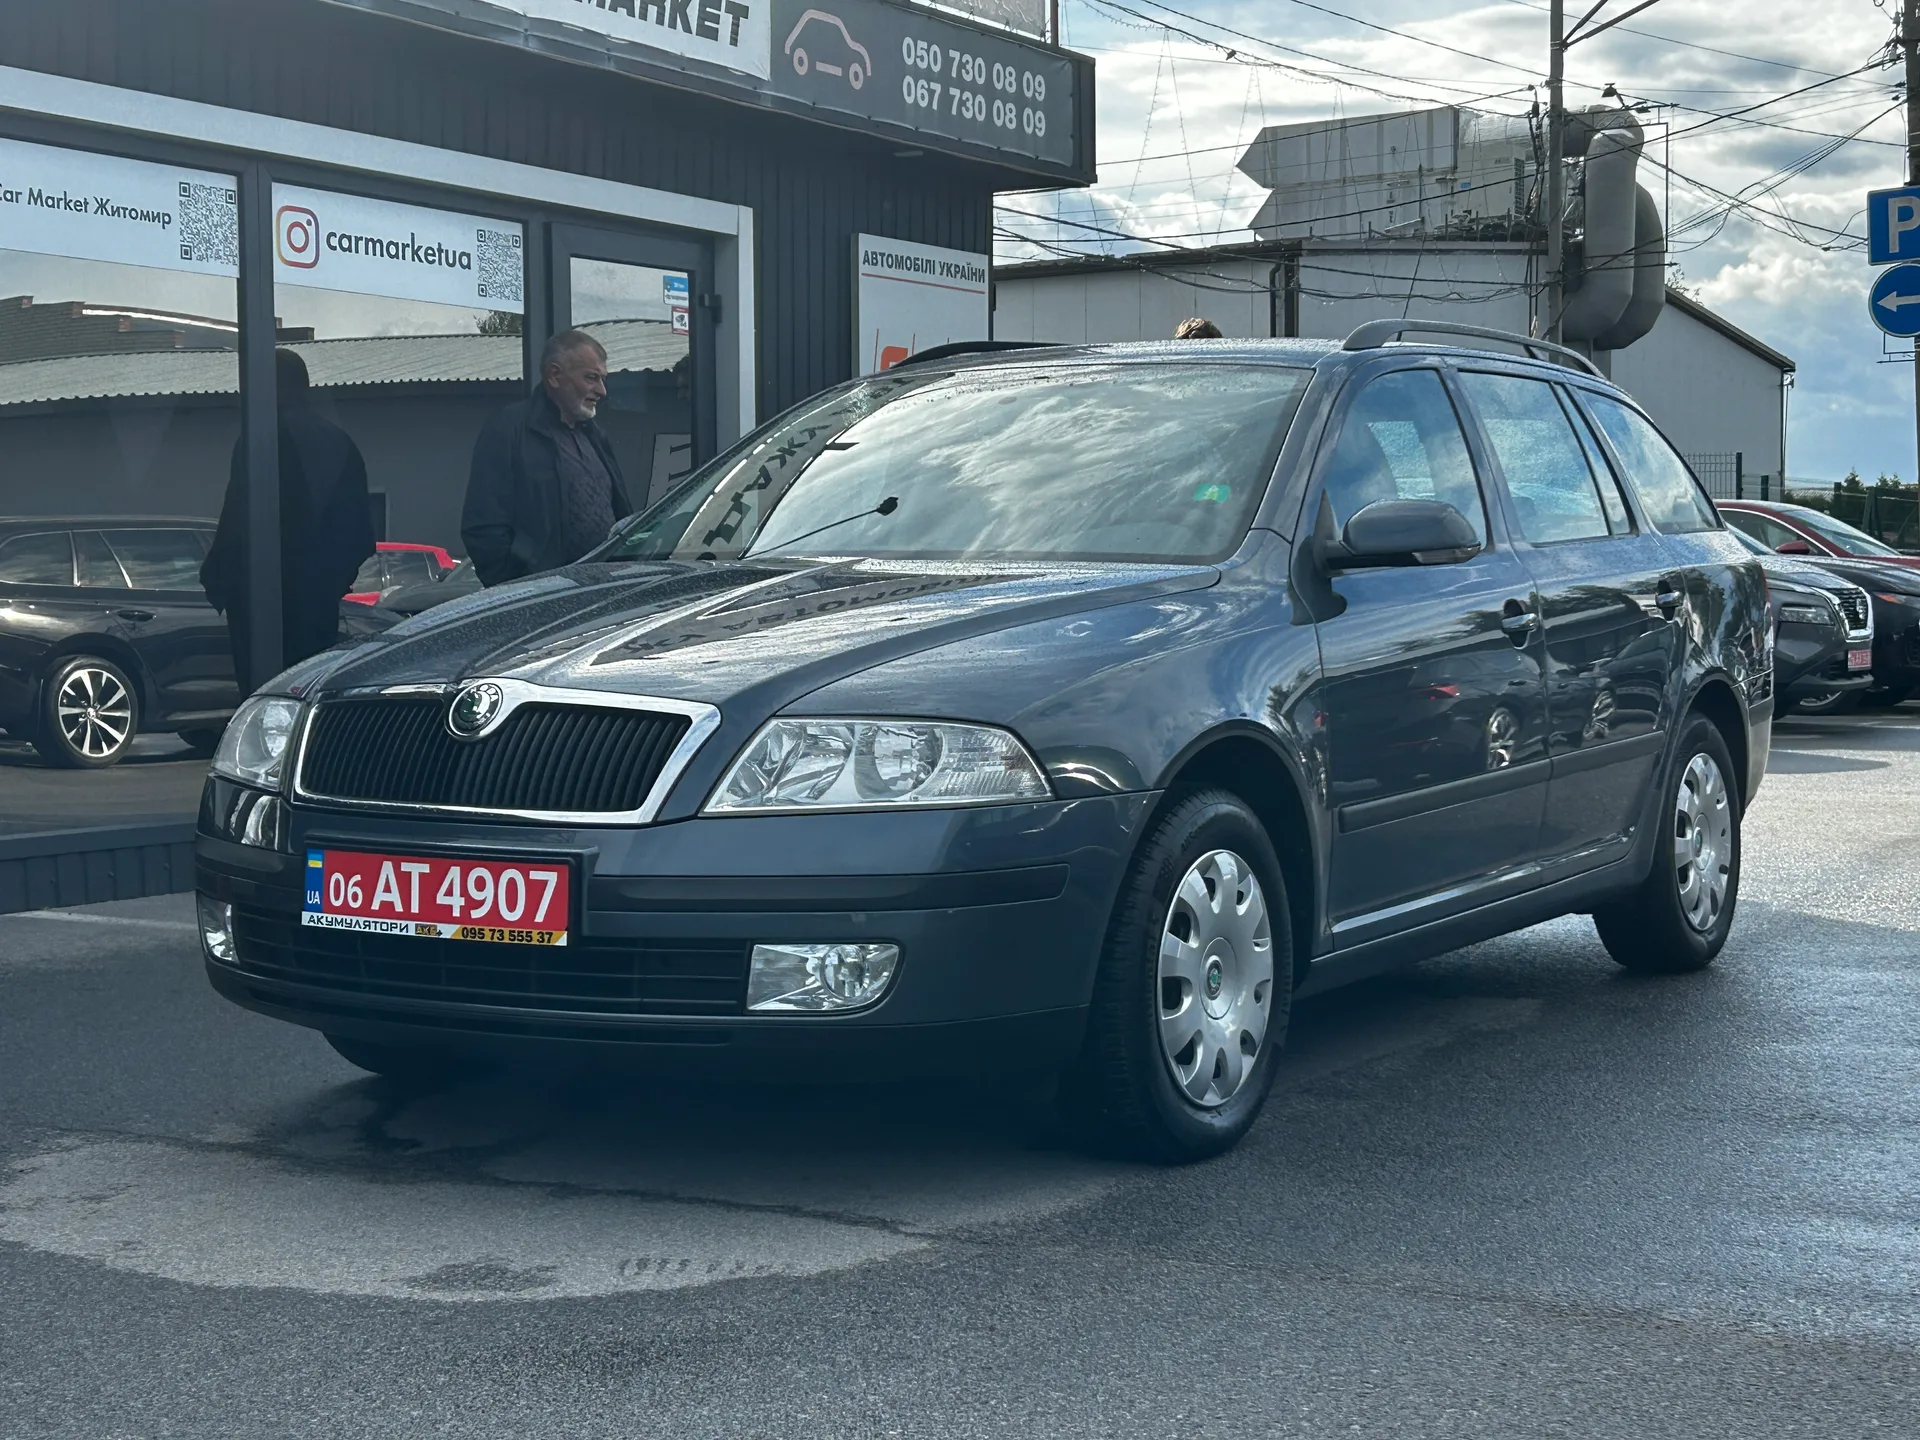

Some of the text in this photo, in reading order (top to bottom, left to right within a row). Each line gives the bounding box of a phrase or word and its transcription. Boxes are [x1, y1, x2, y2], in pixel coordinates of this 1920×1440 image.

[575, 0, 750, 48] RKET
[902, 36, 1046, 102] 050 730 08 09
[902, 74, 1046, 138] 067 730 08 09
[0, 182, 172, 230] ar Market Житомир
[1887, 195, 1920, 254] P
[325, 231, 472, 271] carmarketua
[862, 249, 986, 284] АВТОМОБІЛІ УКРАЇНИ
[306, 890, 321, 905] UA
[329, 860, 558, 923] 06 AT 4907
[307, 914, 409, 934] АКУМУЛЯТОРИ
[461, 926, 486, 940] 095
[488, 928, 505, 942] 73
[508, 929, 533, 943] 555
[536, 930, 554, 944] 37
